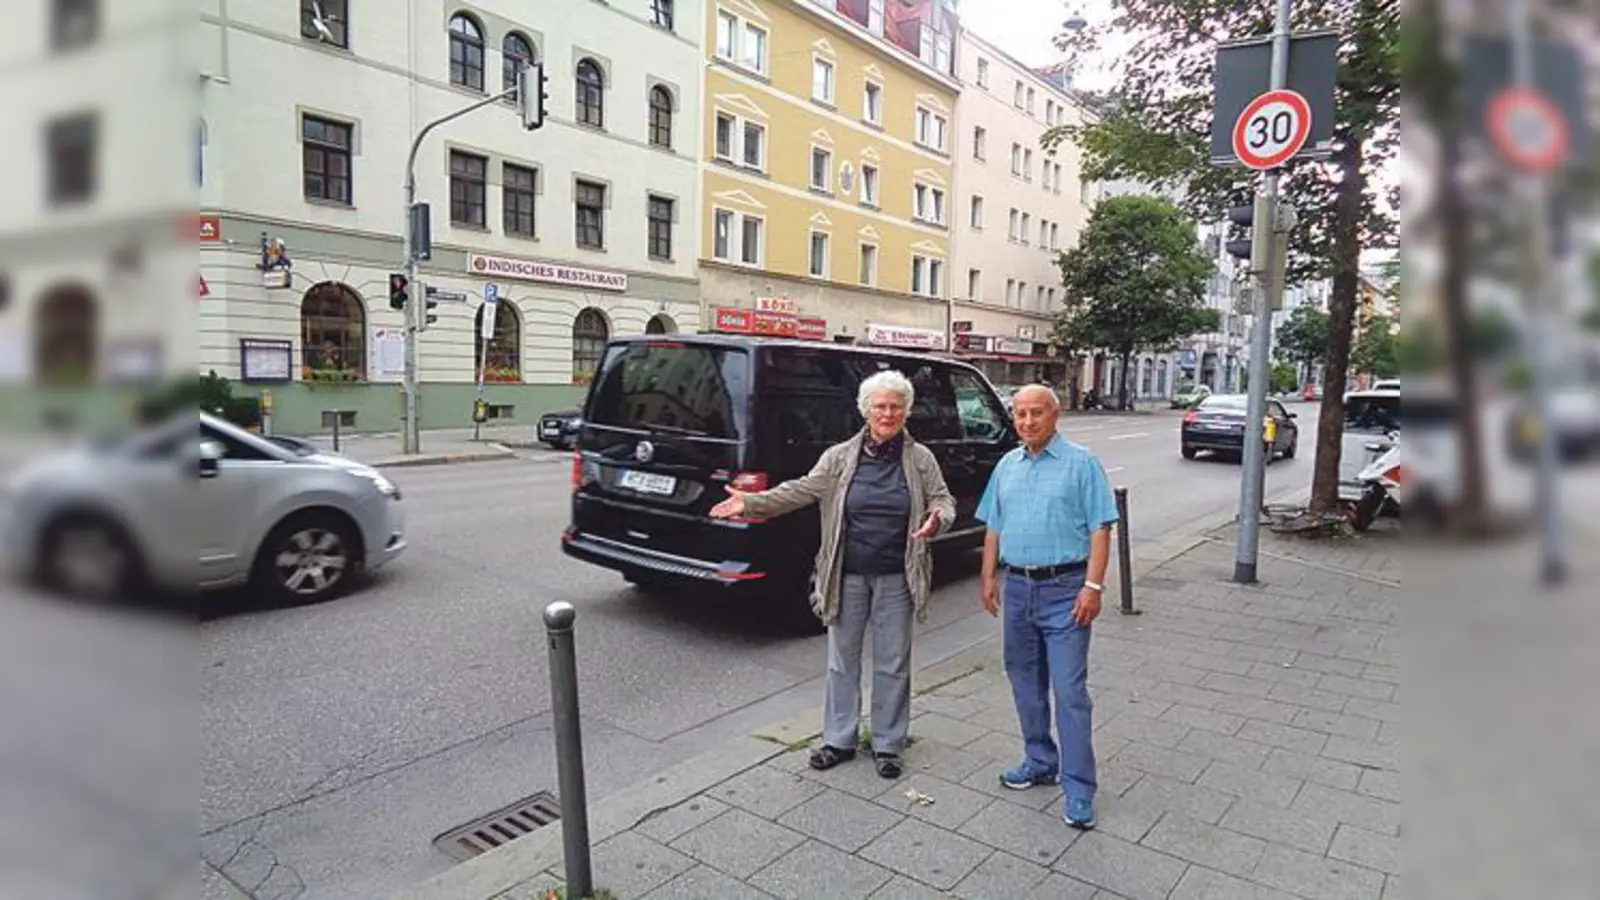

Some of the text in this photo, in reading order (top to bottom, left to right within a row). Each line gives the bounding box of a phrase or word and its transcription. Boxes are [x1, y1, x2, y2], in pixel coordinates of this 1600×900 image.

[1250, 111, 1292, 148] 30
[488, 259, 625, 287] INDISCHES RESTAURANT
